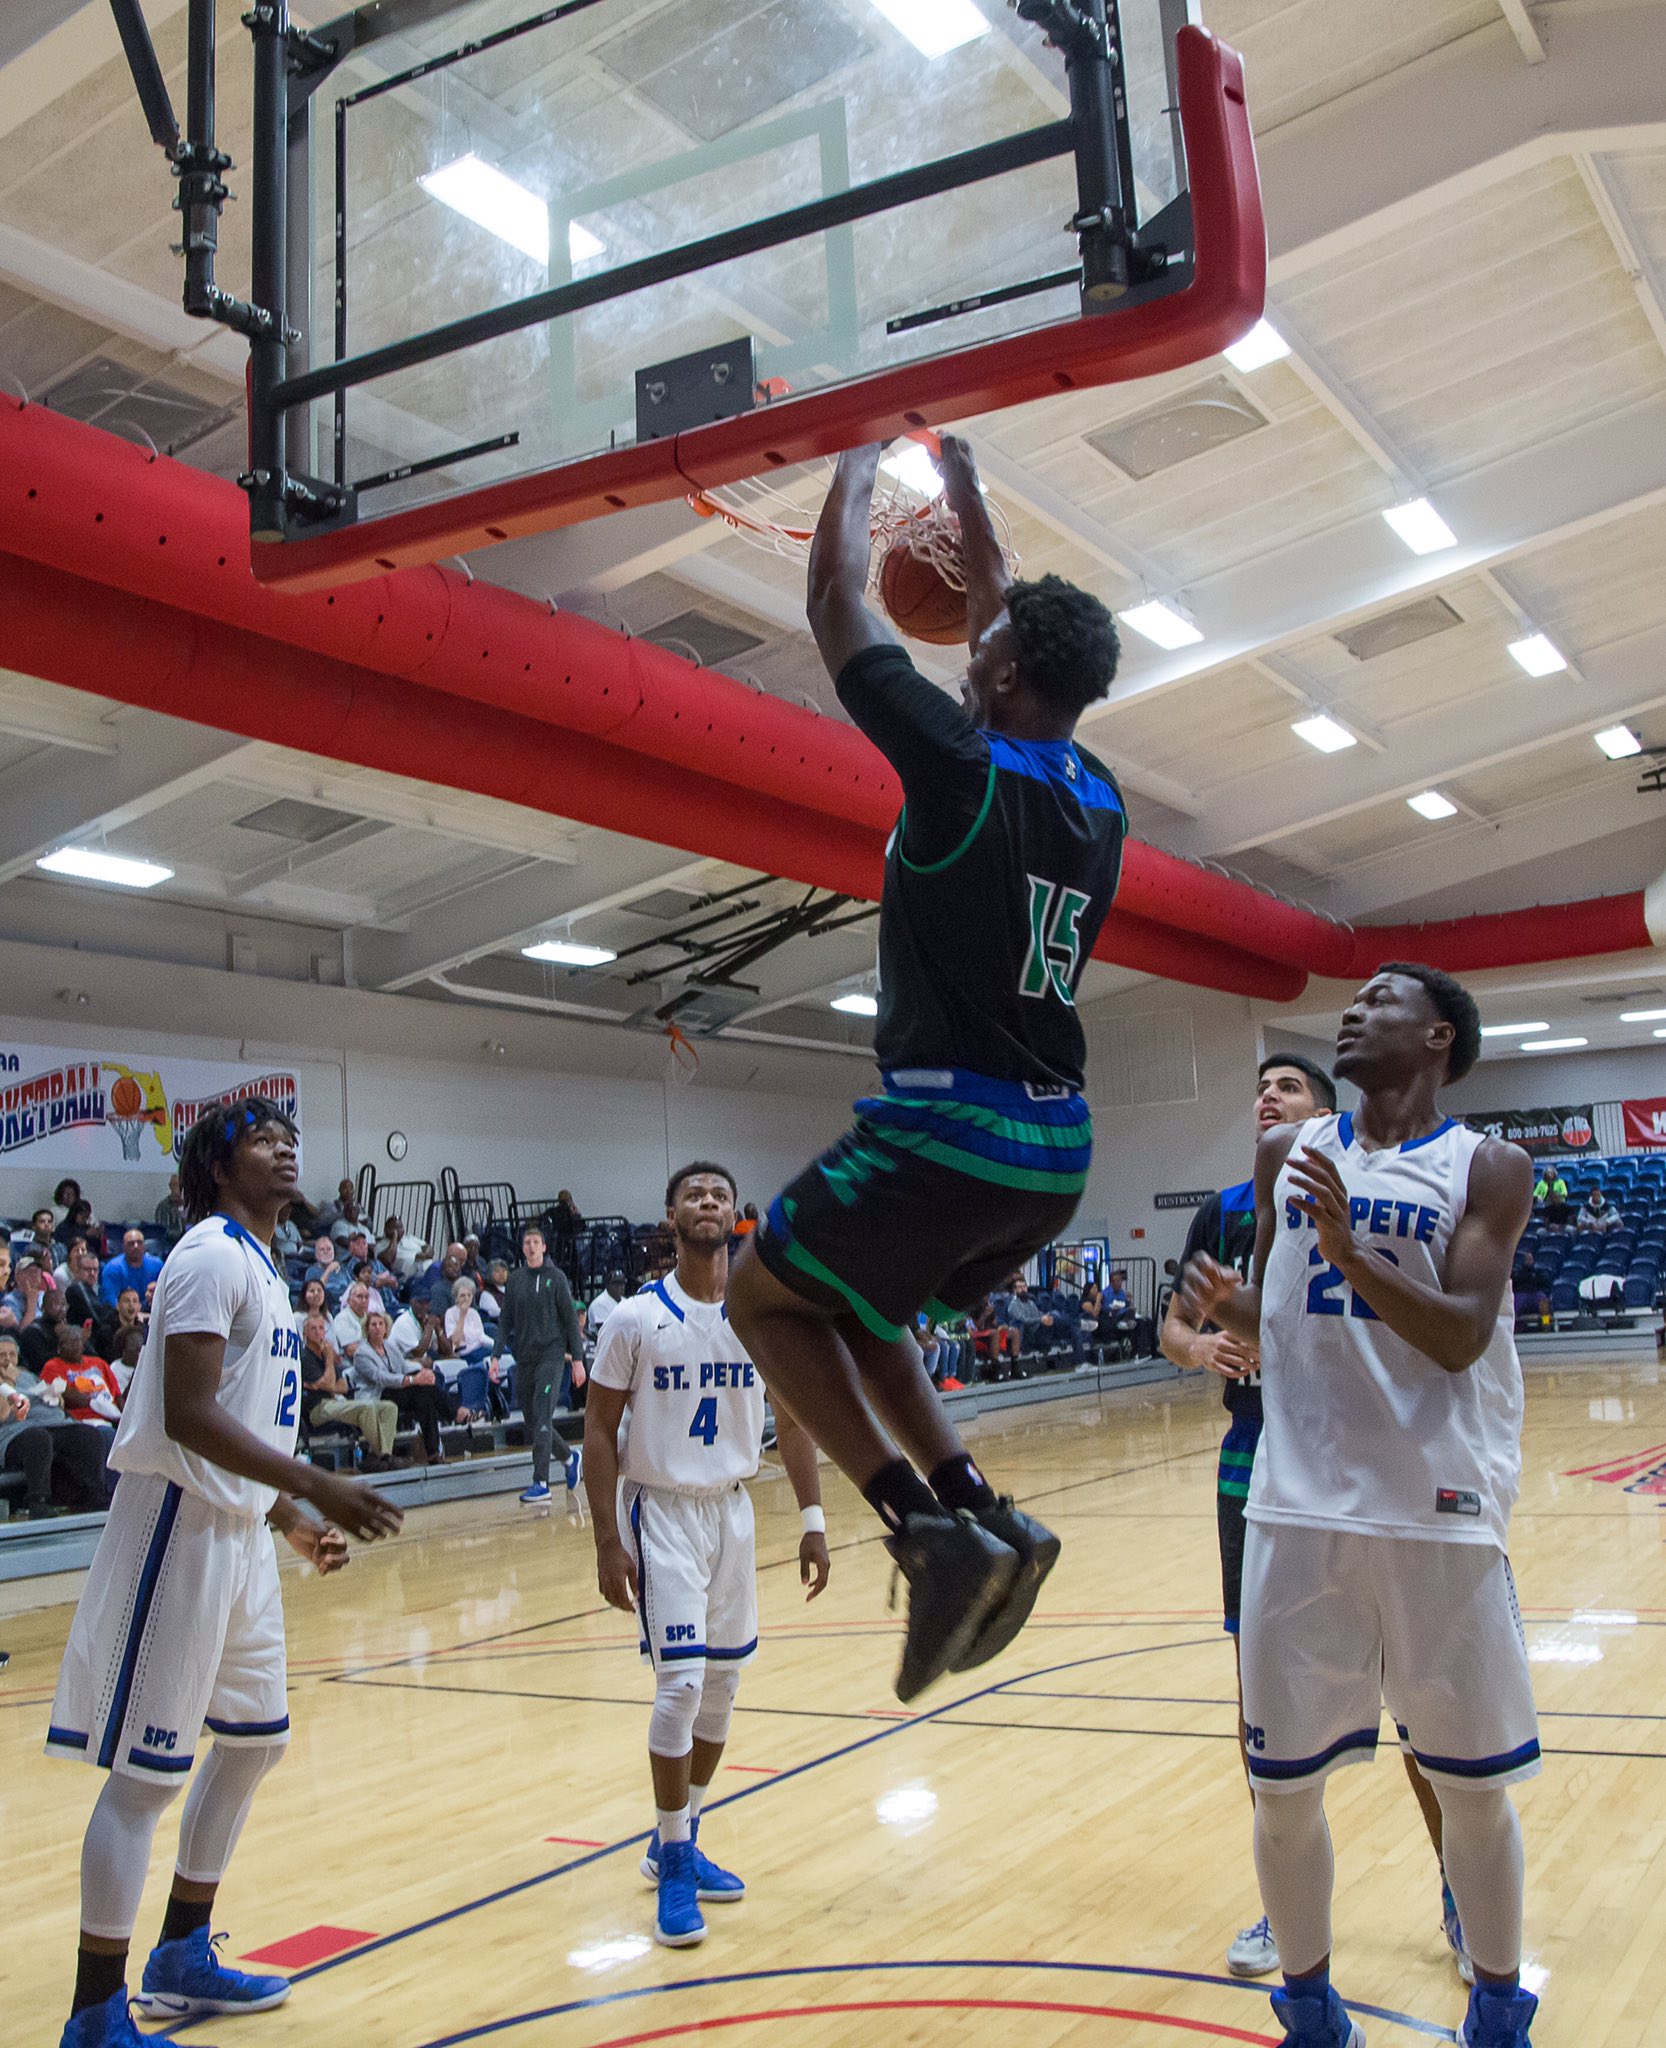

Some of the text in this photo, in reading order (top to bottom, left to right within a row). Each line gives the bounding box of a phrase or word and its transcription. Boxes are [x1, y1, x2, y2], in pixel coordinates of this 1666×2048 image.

[1019, 873, 1092, 1006] 15
[1350, 1196, 1440, 1243] PETE
[274, 1368, 297, 1426] 12
[653, 1362, 755, 1390] ST. PETE
[689, 1397, 718, 1445] 4
[665, 1624, 696, 1641] SPC
[143, 1724, 178, 1750] SPC
